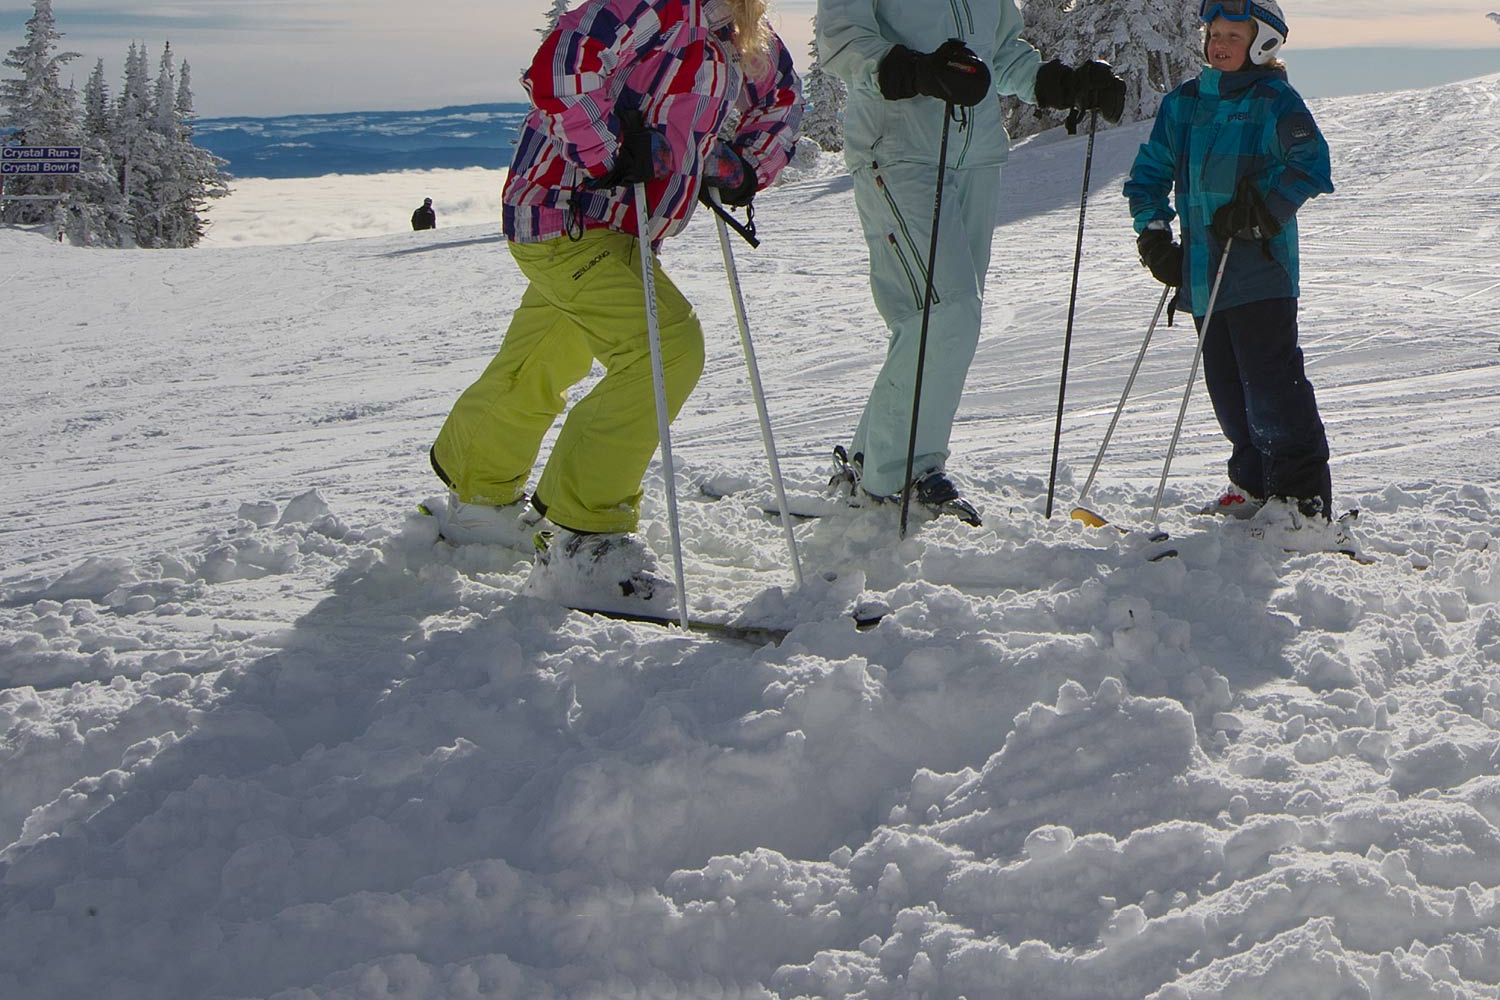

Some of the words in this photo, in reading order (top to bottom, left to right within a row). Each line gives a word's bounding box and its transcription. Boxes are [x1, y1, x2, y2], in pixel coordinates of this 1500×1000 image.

[3, 148, 43, 159] Crystal
[48, 148, 69, 157] Run
[2, 163, 39, 173] Crystal
[43, 163, 69, 171] Bowl
